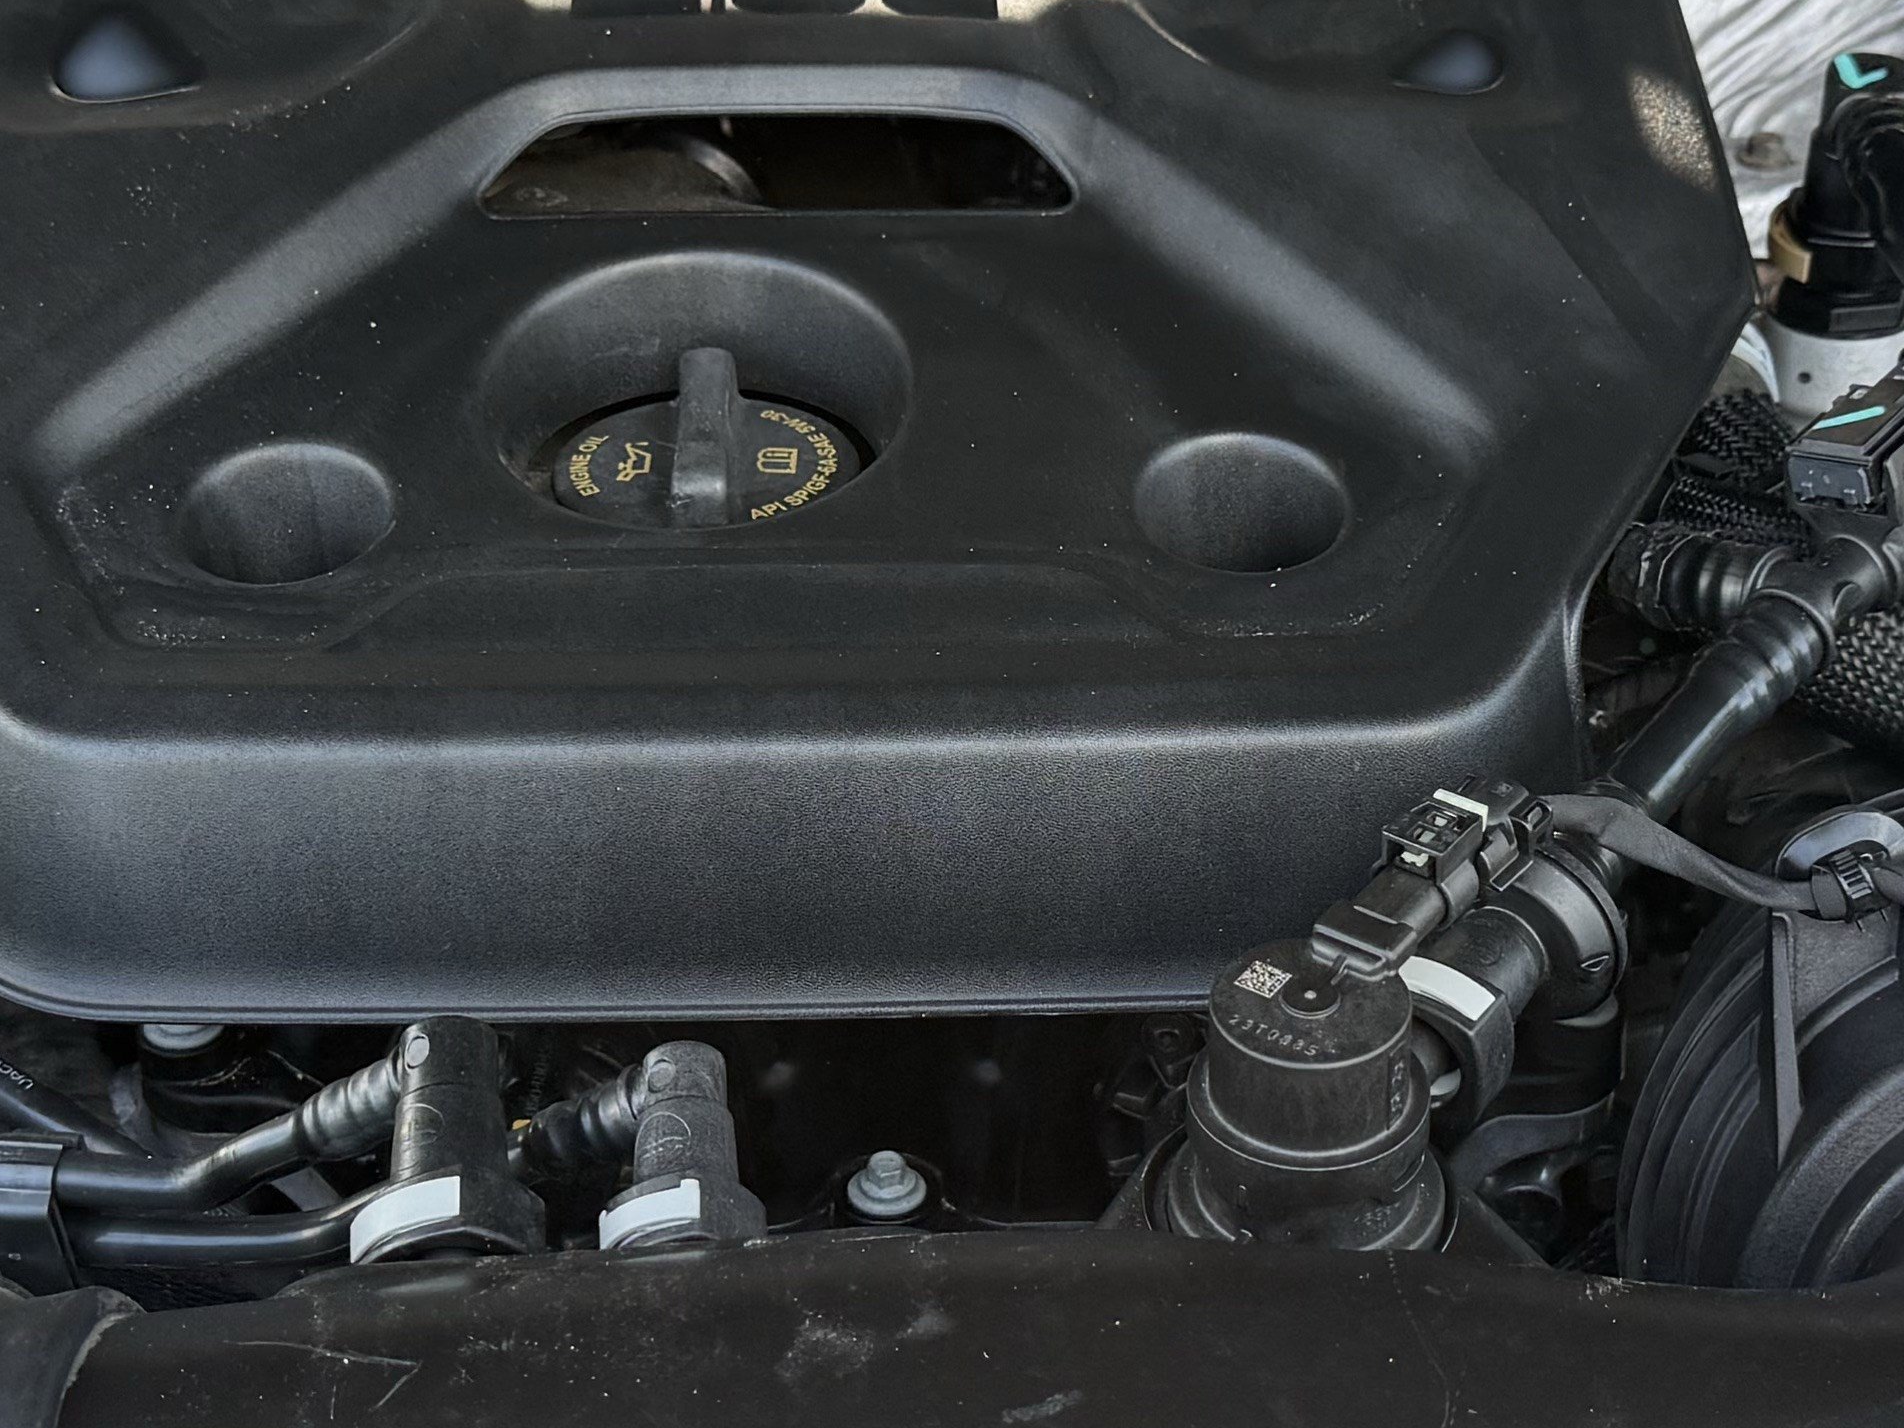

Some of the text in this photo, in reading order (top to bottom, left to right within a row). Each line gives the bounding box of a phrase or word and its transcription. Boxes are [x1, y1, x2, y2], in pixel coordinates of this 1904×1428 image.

[568, 433, 610, 497] ENGINE OIL
[750, 501, 788, 520] API
